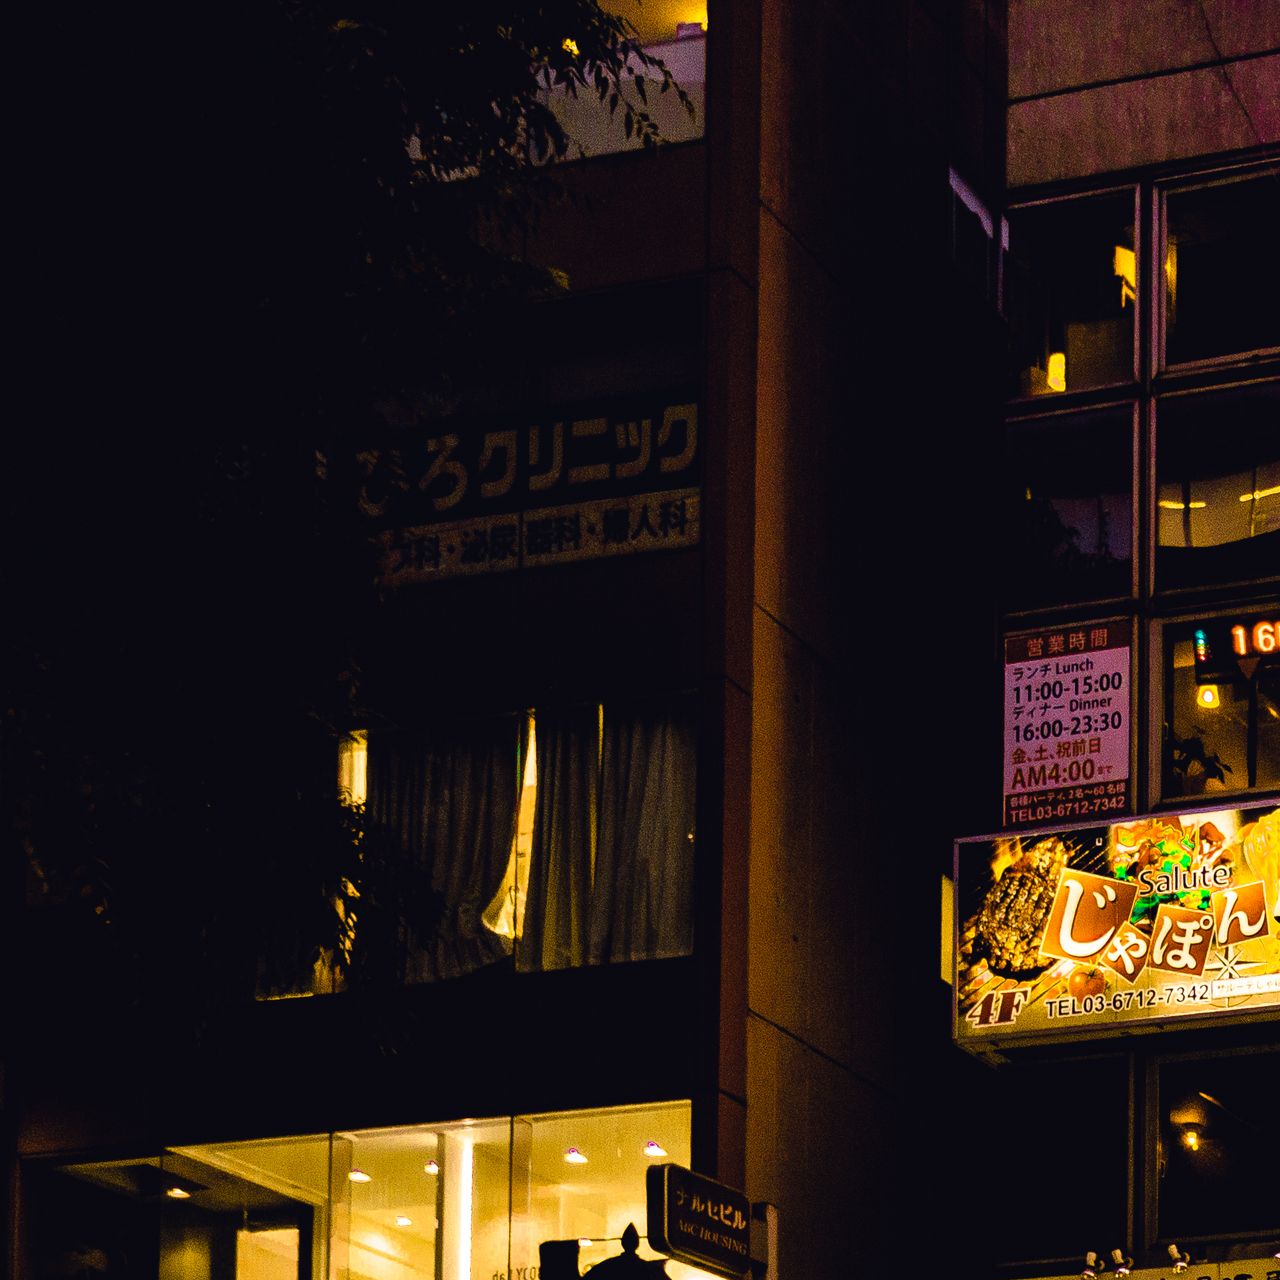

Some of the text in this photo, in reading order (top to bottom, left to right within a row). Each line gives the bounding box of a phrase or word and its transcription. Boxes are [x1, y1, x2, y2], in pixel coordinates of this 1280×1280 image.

[1027, 628, 1109, 657] 営業時間
[1013, 658, 1093, 681] ランチ Lunch
[1013, 672, 1122, 703] 11:00-15:00
[1069, 697, 1112, 712] Dinner
[1013, 711, 1122, 743] 16:00-23:30
[1012, 738, 1101, 765] 金、土、祝前日
[1011, 759, 1095, 790] AM4:00
[1010, 796, 1126, 823] TEL03-6712-7342
[1139, 865, 1234, 897] Salute
[1057, 878, 1267, 976] じゃぽん
[966, 986, 1031, 1028] 4F
[1046, 984, 1210, 1020] TEL03-6712-7342
